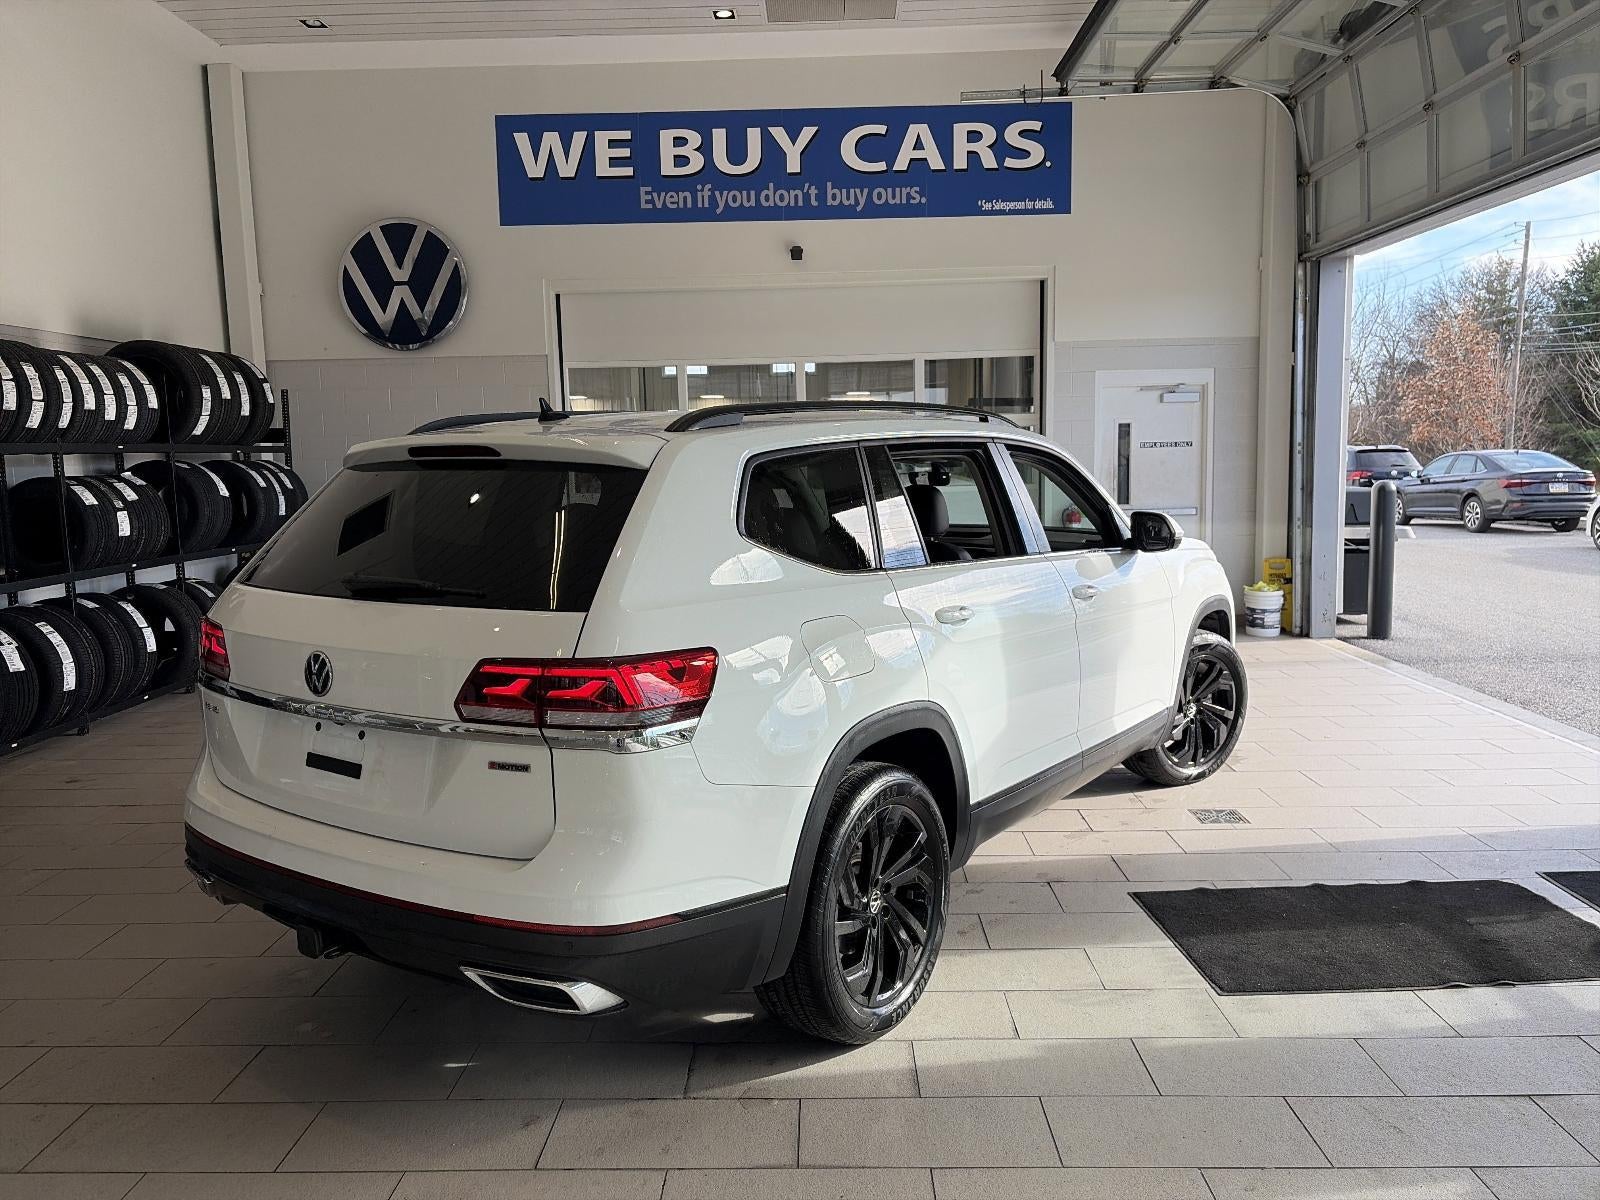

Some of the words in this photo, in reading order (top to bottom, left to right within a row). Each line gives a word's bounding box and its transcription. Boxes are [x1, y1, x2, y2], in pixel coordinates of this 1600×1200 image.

[513, 130, 635, 180] WE
[659, 126, 819, 177] BUY
[840, 120, 1052, 173] CARS.
[640, 186, 692, 208] Even
[697, 183, 712, 208] if
[715, 190, 756, 214] you
[760, 182, 818, 207] don't
[827, 181, 869, 211] buy
[873, 186, 928, 204] ours.
[993, 199, 1025, 212] Salesperson
[1026, 198, 1034, 209] for
[1035, 198, 1055, 209] details.
[338, 217, 468, 351] VW
